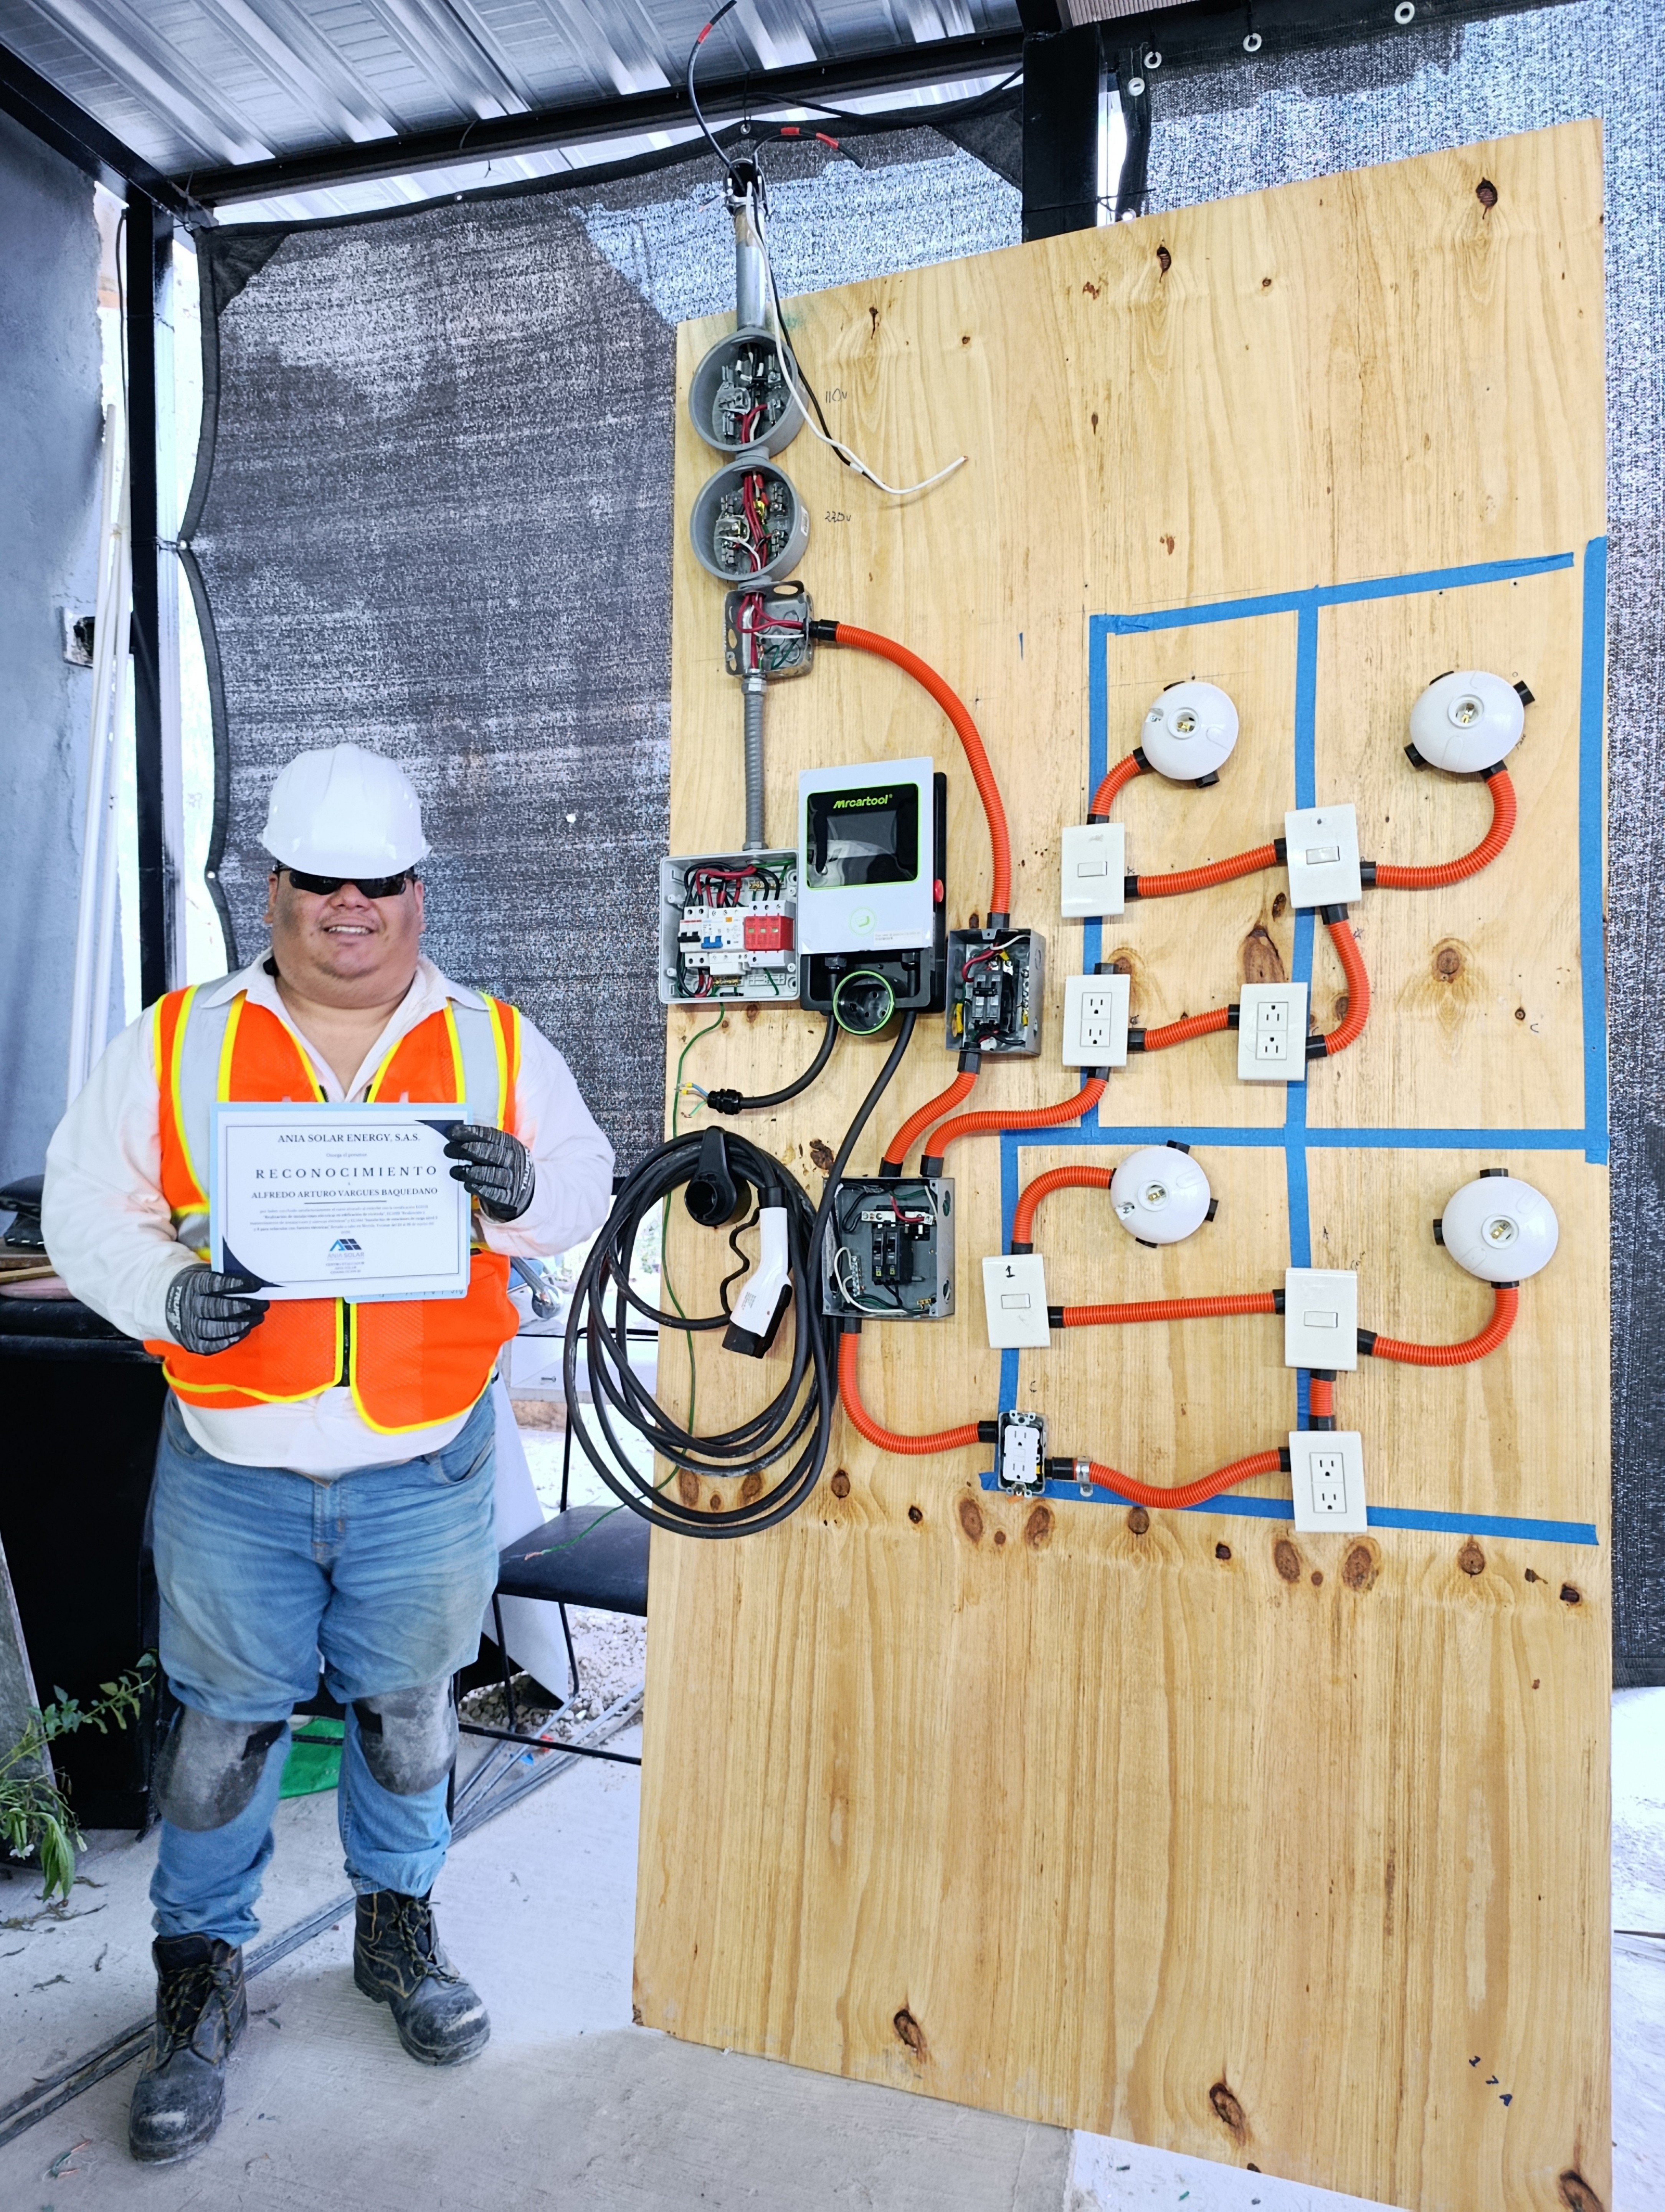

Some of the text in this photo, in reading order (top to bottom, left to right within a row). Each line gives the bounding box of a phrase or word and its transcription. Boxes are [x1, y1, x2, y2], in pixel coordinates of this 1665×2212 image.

[307, 1134, 344, 1142] SOLAR
[395, 1133, 420, 1141] S.A.S.
[256, 1166, 436, 1179] RECONOCIMIENTO
[382, 1187, 438, 1197] BAQUEDANO
